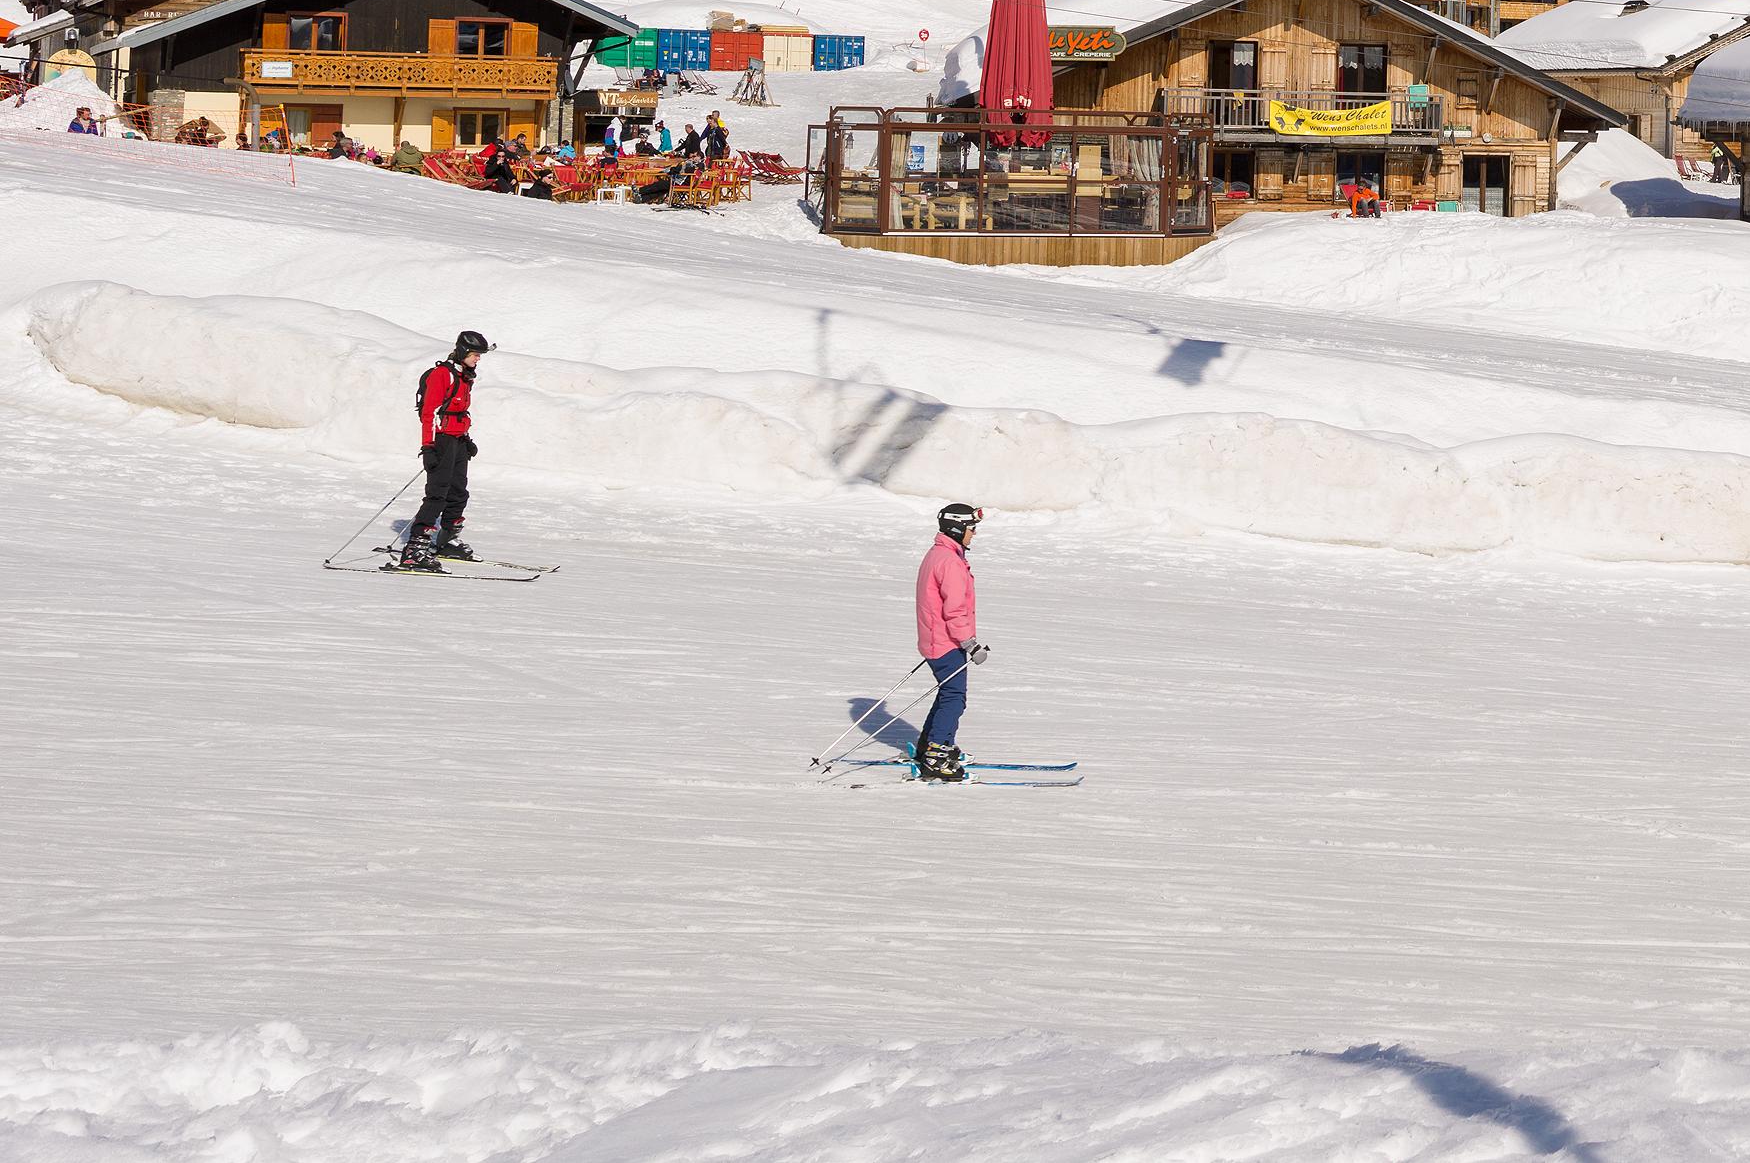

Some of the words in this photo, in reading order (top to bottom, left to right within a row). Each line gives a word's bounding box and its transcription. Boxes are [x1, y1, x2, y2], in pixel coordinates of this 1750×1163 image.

[1067, 30, 1115, 54] Yeti
[1311, 111, 1341, 121] Wens
[1346, 109, 1387, 121] Chalet
[1309, 123, 1388, 132] www.wenschalets.nl
